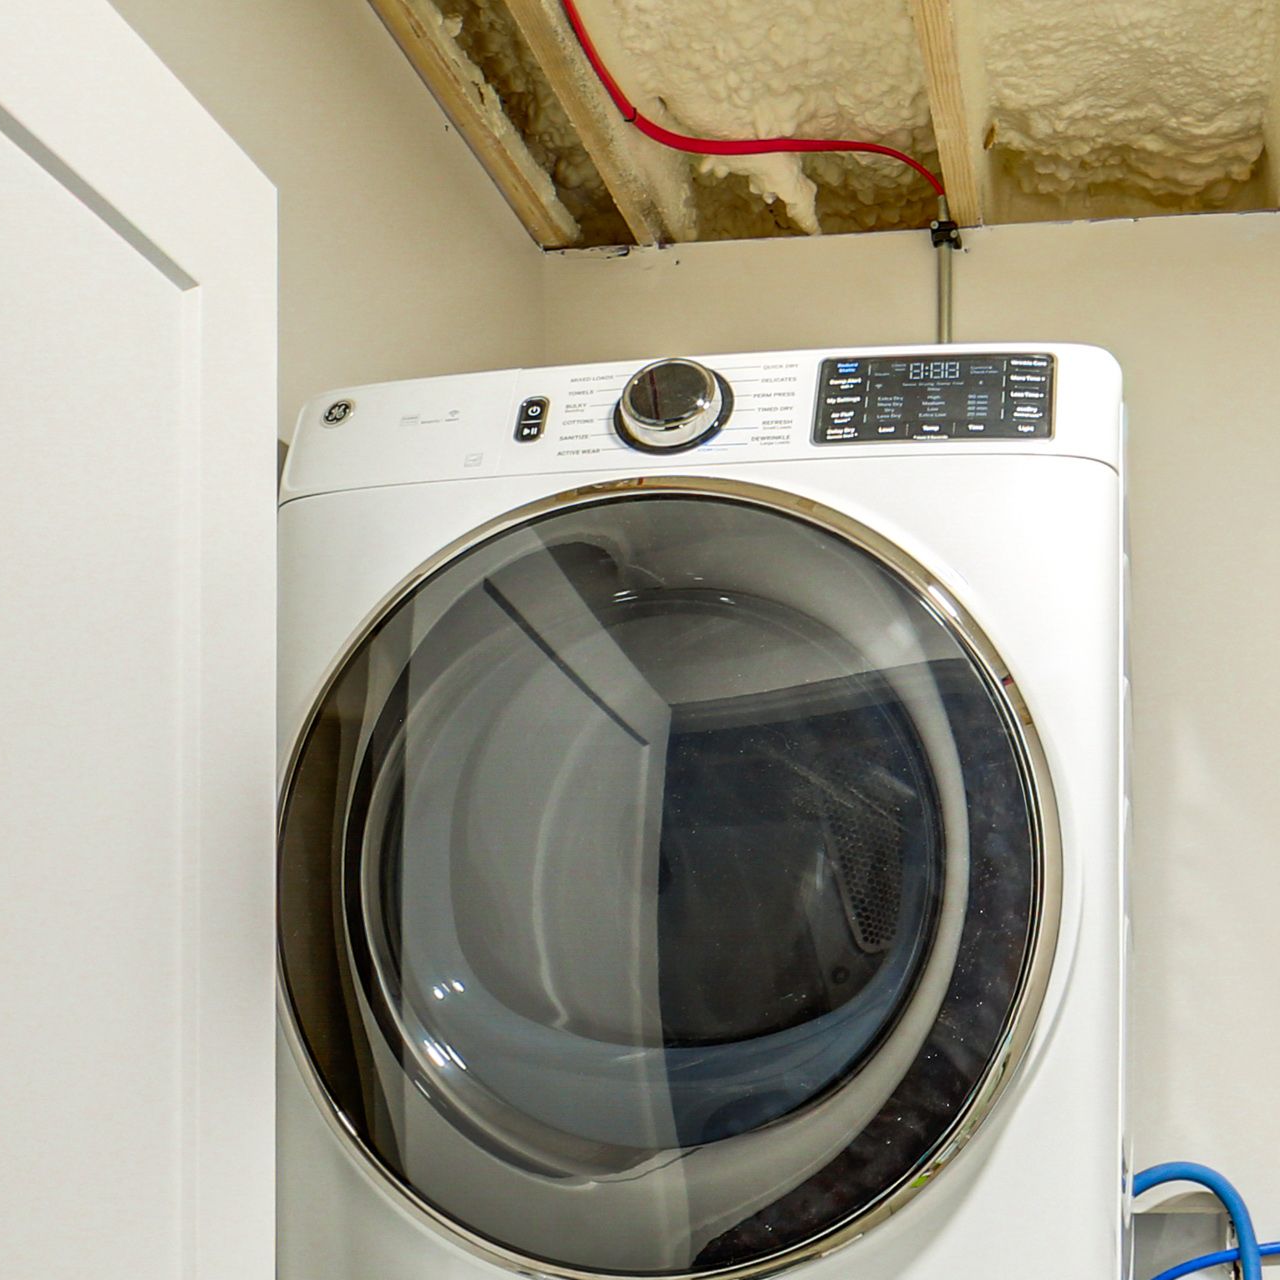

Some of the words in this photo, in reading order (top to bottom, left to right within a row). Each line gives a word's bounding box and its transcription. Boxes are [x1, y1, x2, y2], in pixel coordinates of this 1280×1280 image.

[837, 396, 861, 404] Settings
[922, 424, 940, 432] Temp
[1017, 424, 1035, 433] Light
